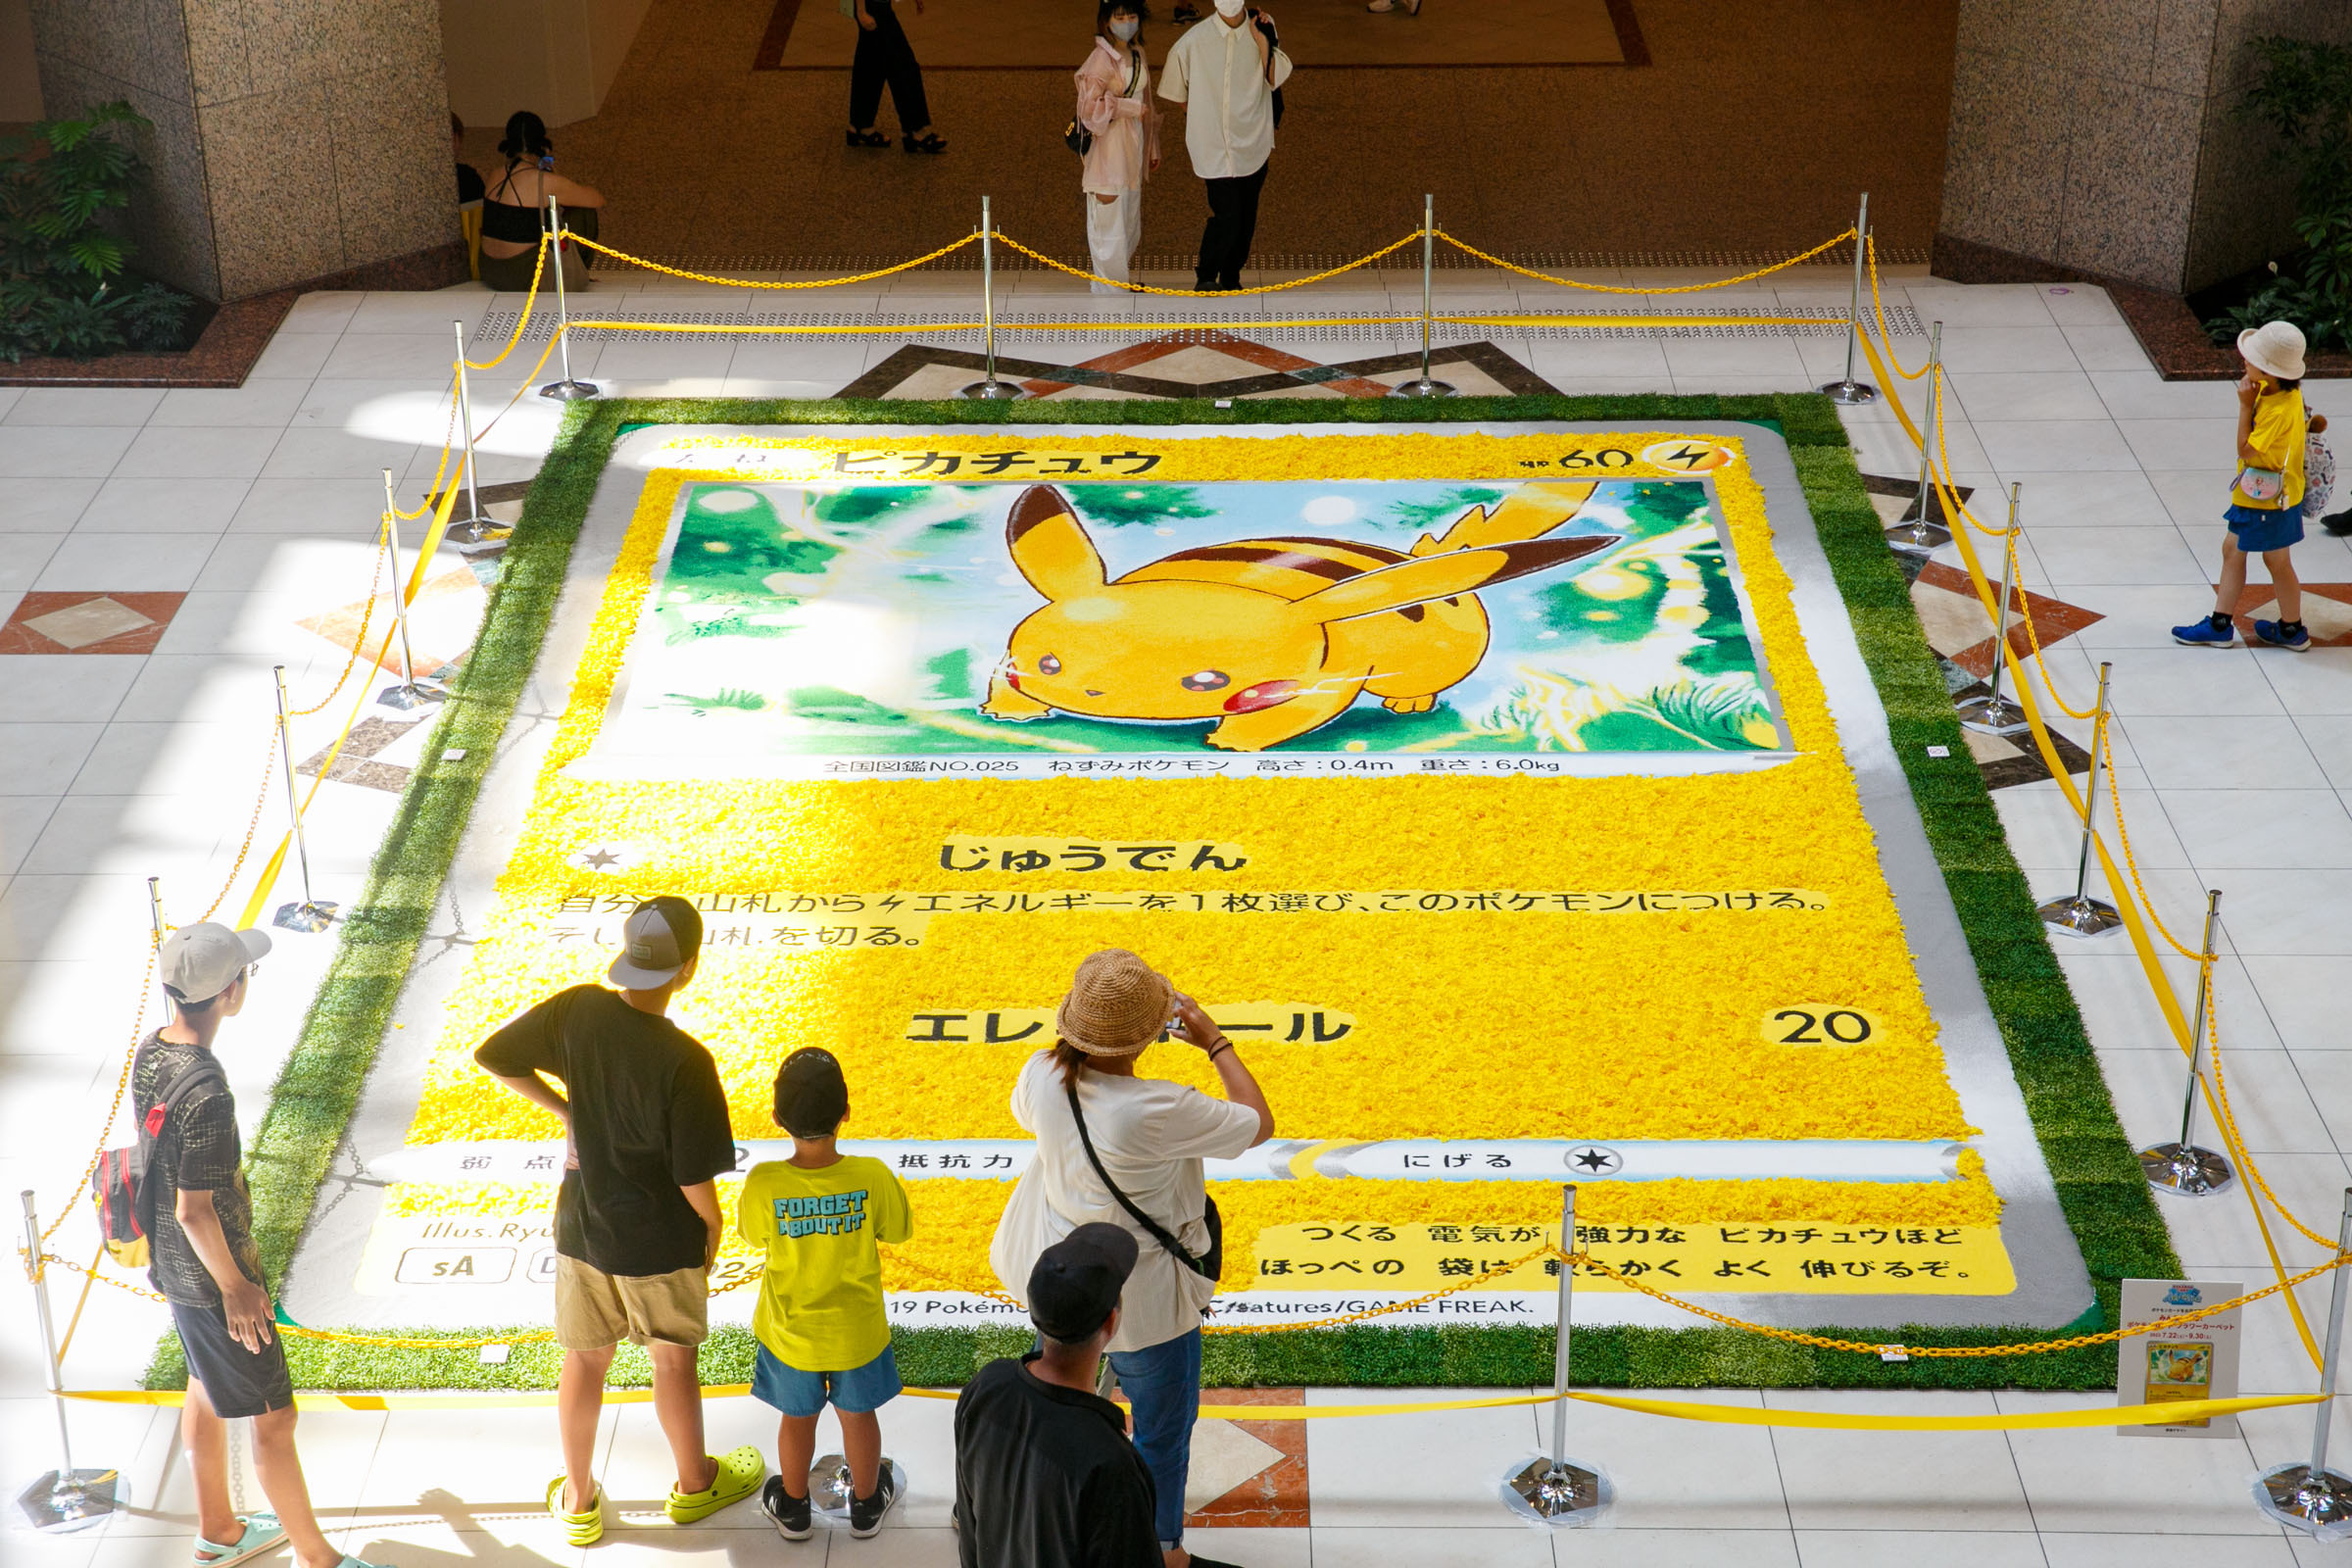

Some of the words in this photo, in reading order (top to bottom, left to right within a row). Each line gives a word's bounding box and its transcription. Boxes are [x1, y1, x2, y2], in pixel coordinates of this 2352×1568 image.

[835, 449, 1161, 475] ピカチュウ
[1559, 448, 1634, 468] 60
[824, 758, 1019, 774] 全国図鑑NO.025
[1050, 758, 1230, 773] ねずみポケモン
[940, 843, 1249, 873] じゅうでん
[1774, 1009, 1873, 1045] 20
[899, 1152, 1013, 1170] 抵抗力
[1403, 1152, 1513, 1168] にげる
[773, 1189, 868, 1218] FORGET
[778, 1215, 843, 1238] ABOUT
[844, 1212, 866, 1233] IT
[1301, 1224, 1396, 1242] つくる
[1427, 1225, 1542, 1244] 電気が
[1575, 1225, 1687, 1244] 強力な
[1720, 1225, 1964, 1245] ピカチュウほど
[431, 1254, 474, 1277] sA
[1713, 1258, 1772, 1277] よく
[1801, 1259, 1970, 1279] 伸びるぞ。
[1439, 1299, 1535, 1315] FREAK.
